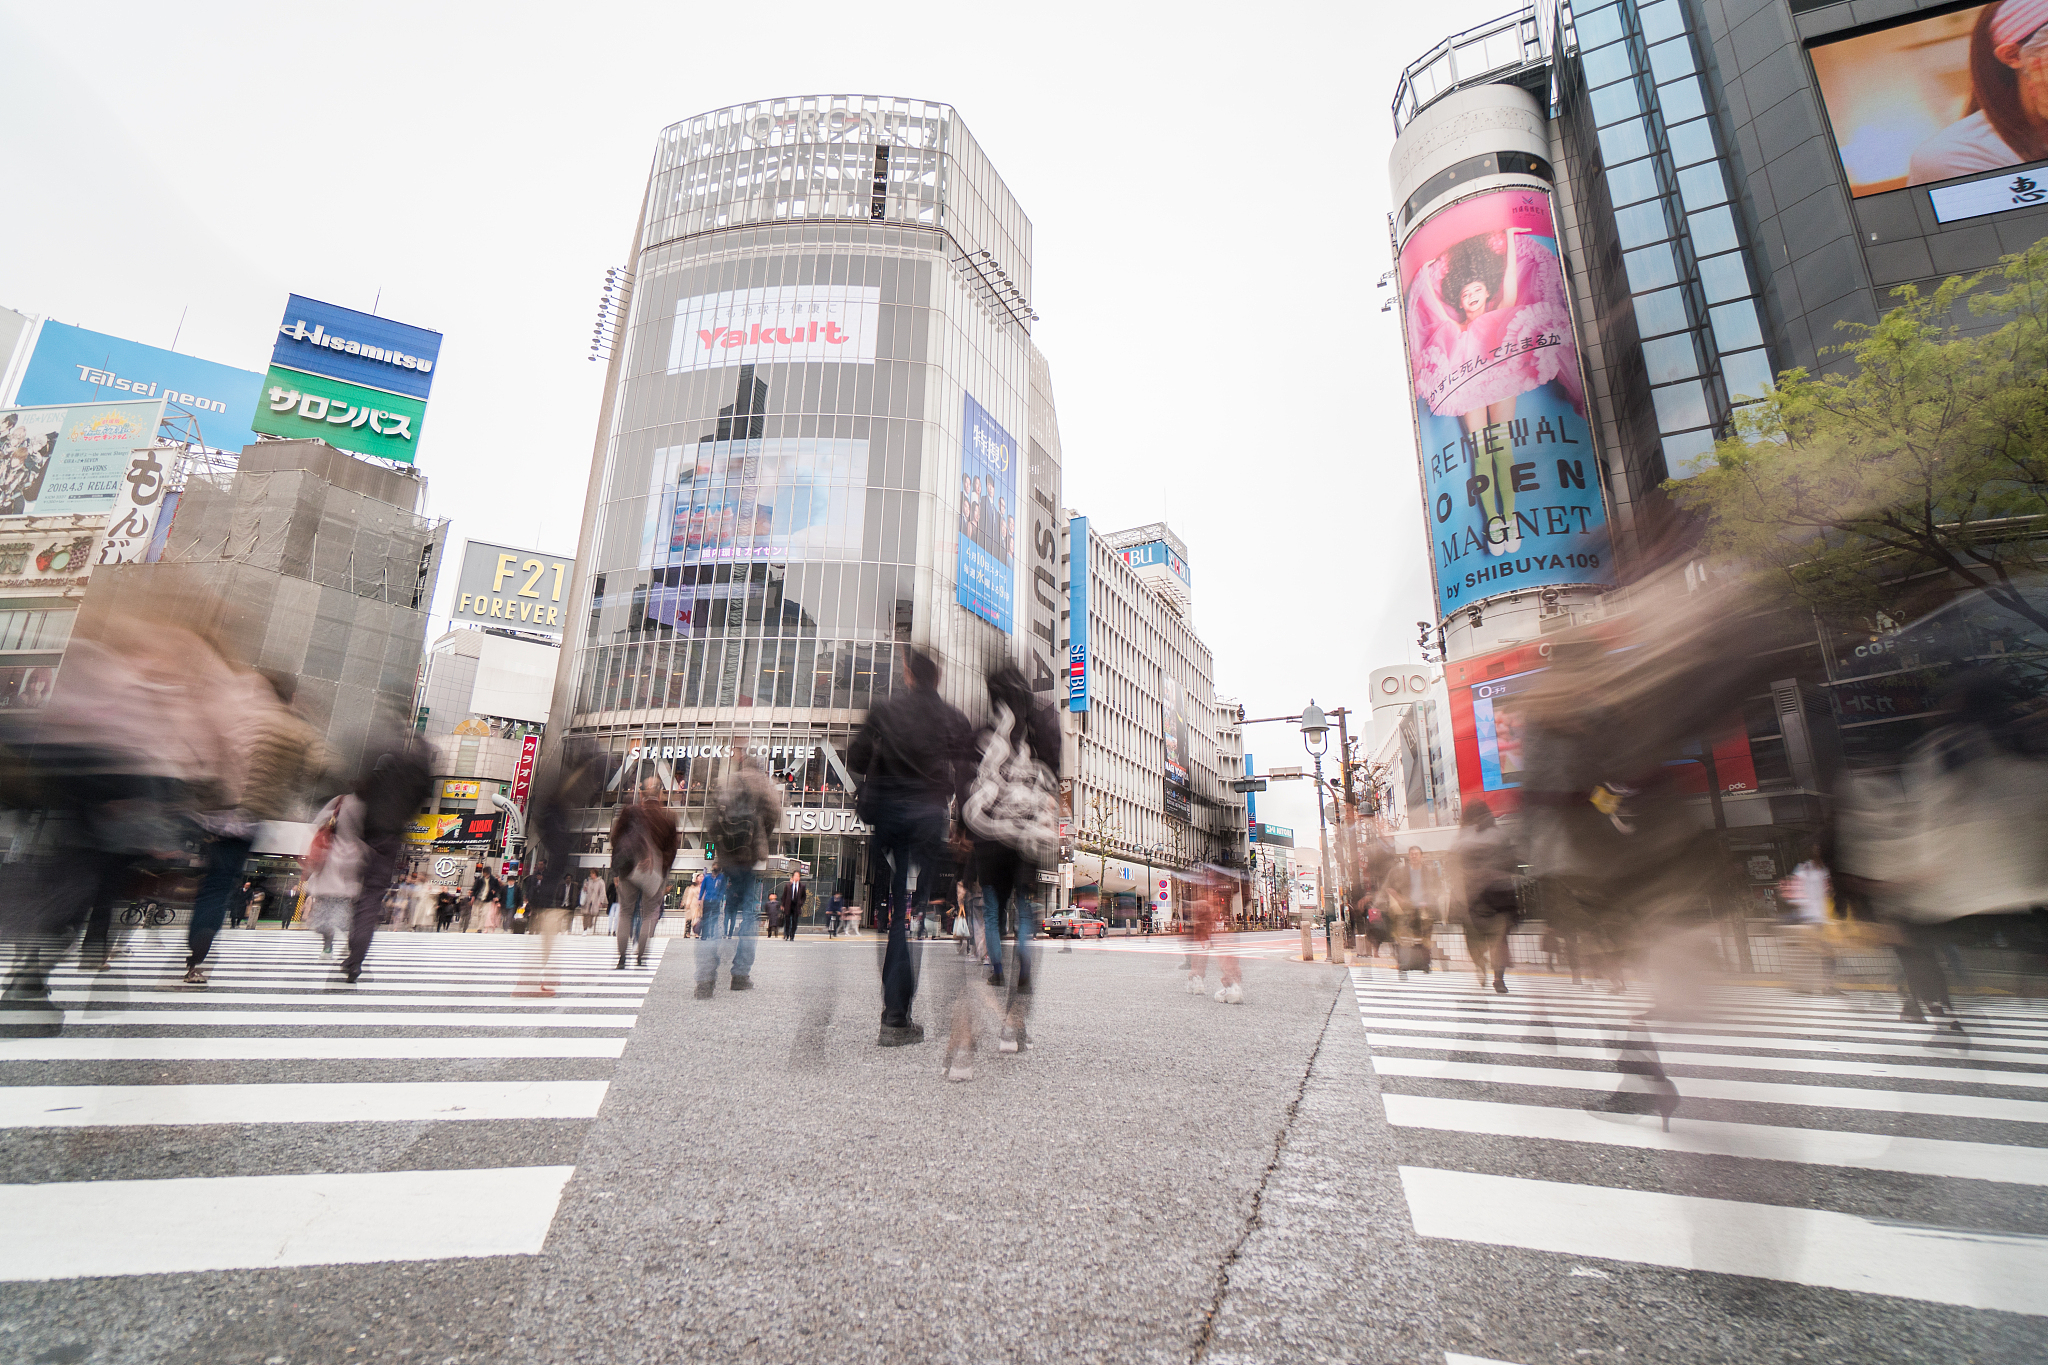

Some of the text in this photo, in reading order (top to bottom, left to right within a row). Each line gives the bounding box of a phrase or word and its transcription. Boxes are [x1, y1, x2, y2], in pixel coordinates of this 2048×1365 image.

[279, 319, 433, 373] Hisamitsu
[696, 321, 849, 350] Yakult
[75, 364, 227, 414] Taisei neon
[268, 385, 412, 440] サロンパス
[1430, 415, 1579, 484] RENEWAL
[47, 481, 119, 493] 2019.4.3 RELEA
[1436, 458, 1586, 524] OPEN
[1441, 505, 1592, 568] MAGNET
[492, 553, 566, 602] F21
[1033, 487, 1056, 693] TSUTA
[1446, 553, 1600, 599] by SHIBUYA109
[458, 593, 559, 626] FOREVER
[630, 744, 817, 760] STARBUCKS COFFEE
[1728, 782, 1747, 791] pdc
[786, 810, 870, 832] TSUTA
